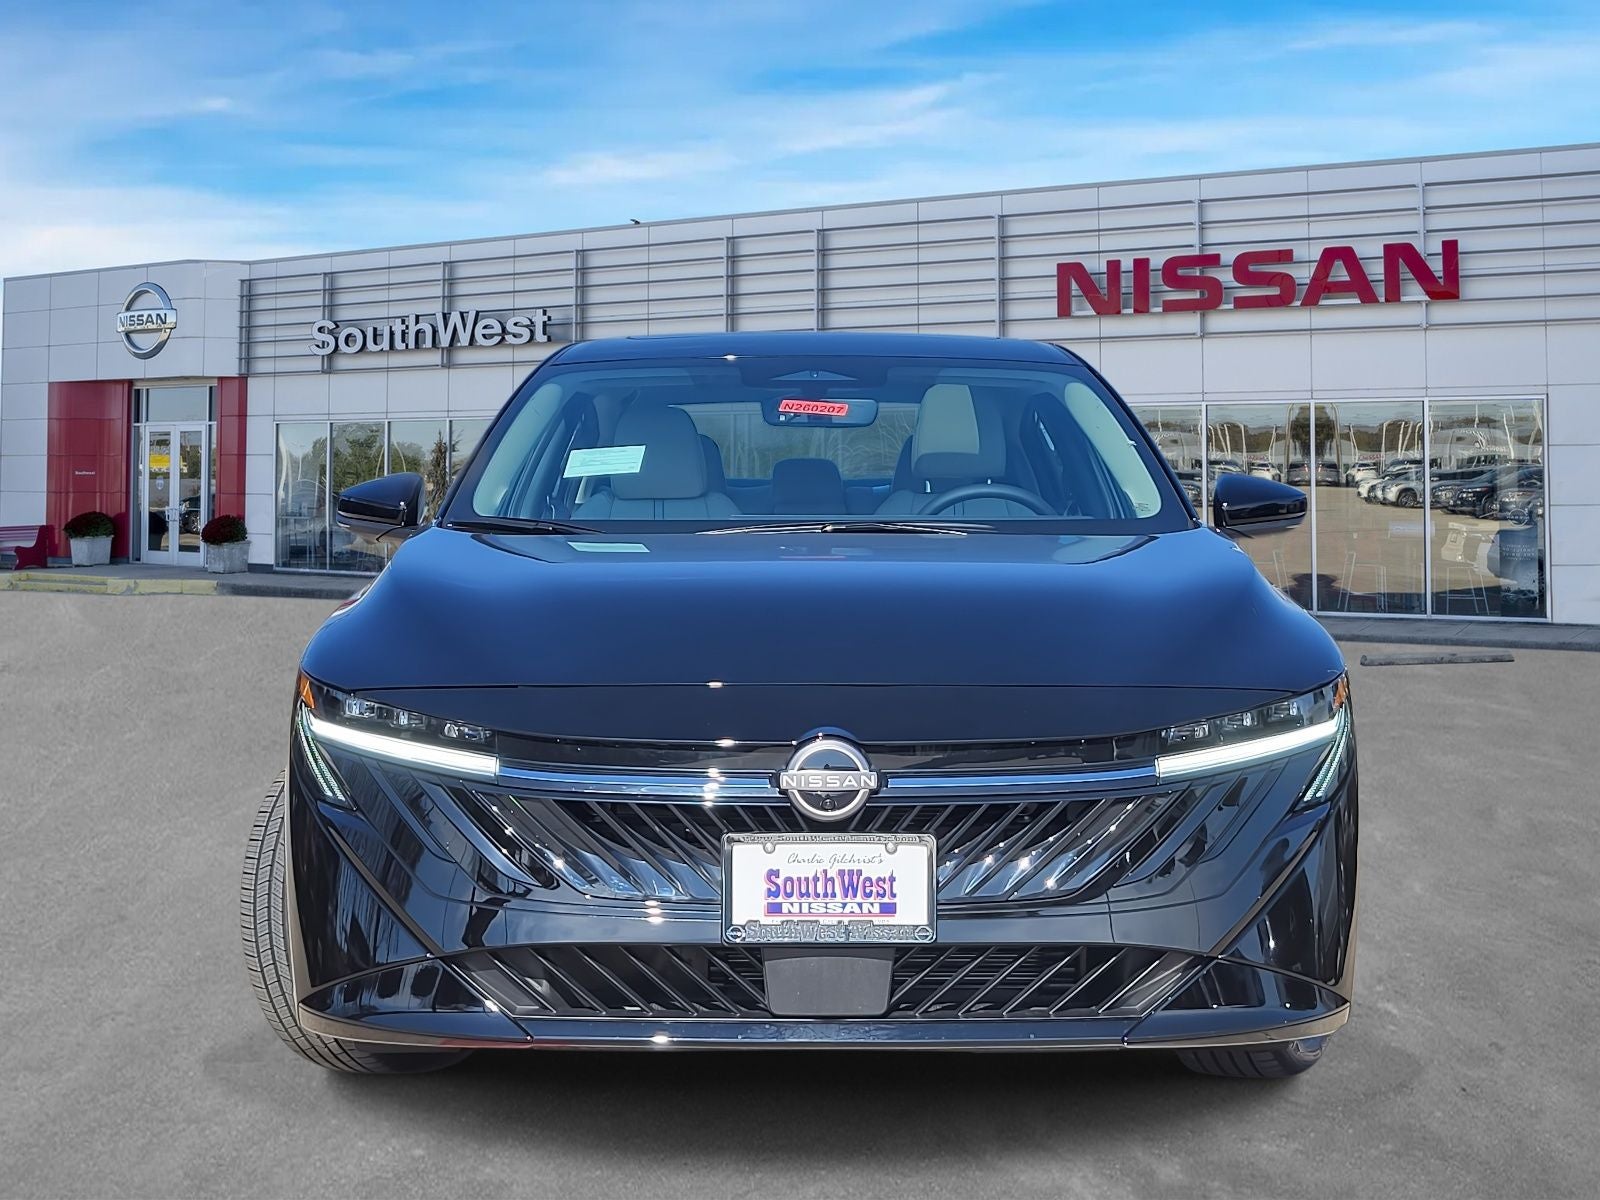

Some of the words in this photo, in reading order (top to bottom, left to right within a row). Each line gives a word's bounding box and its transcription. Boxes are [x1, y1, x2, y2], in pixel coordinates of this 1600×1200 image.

[1057, 239, 1461, 318] NISSAN
[119, 313, 167, 327] NISSAN
[309, 308, 551, 355] SouthWest
[783, 403, 844, 414] N260207
[782, 775, 876, 788] NISSAN
[787, 853, 825, 864] Charlie
[828, 853, 885, 869] Gilchrist's
[764, 868, 897, 900] SouthWest
[782, 902, 881, 914] NISSAN
